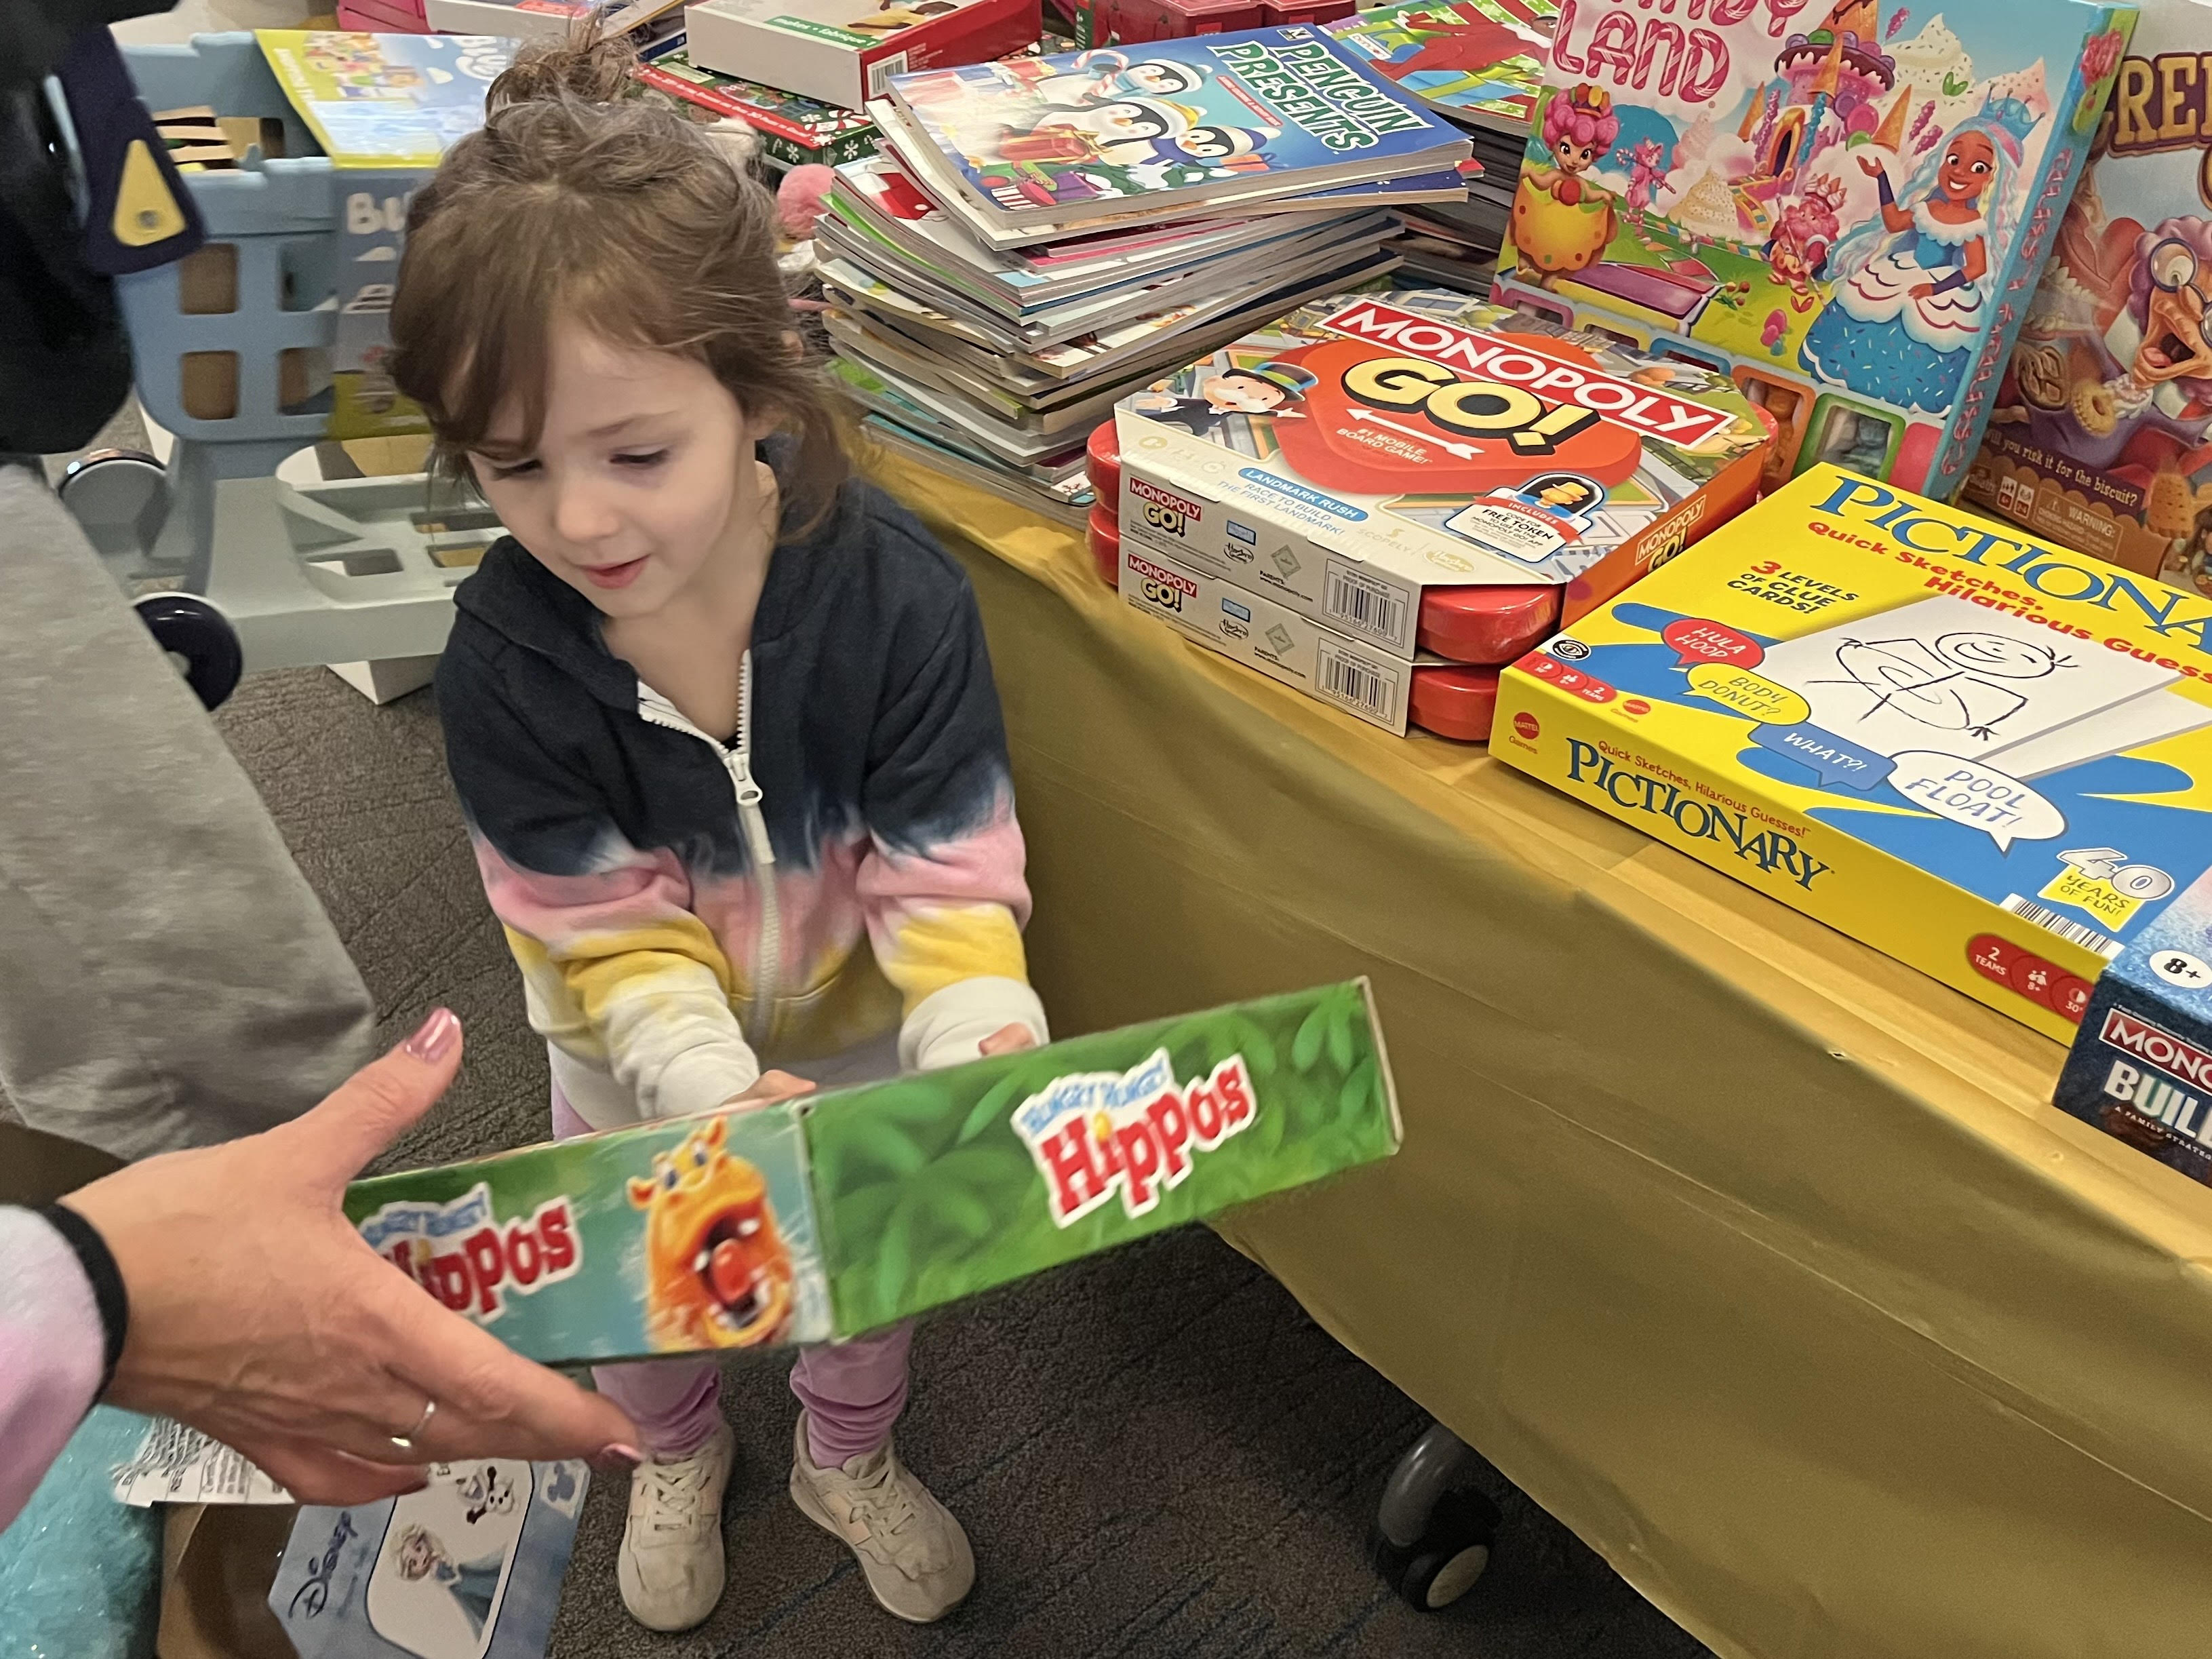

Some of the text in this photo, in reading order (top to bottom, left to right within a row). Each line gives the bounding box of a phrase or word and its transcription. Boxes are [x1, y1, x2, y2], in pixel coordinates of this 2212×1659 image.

[1552, 0, 1730, 102] LAND
[1207, 41, 1379, 151] PRESENTS
[1270, 41, 1433, 132] PENGUIN
[1338, 307, 1716, 432] MONOPOLY
[1342, 357, 1601, 455] GO!
[1337, 428, 1379, 453] BOARD
[1378, 441, 1428, 465] GAME!
[1372, 433, 1426, 456] MOBILE
[2002, 439, 2020, 455] you
[2022, 446, 2042, 465] risk
[2045, 455, 2054, 469] it
[2055, 461, 2072, 478] for
[2075, 469, 2093, 487] the
[2094, 477, 2138, 507] biscuit?
[1130, 480, 1201, 519] MONOPOLY
[1217, 481, 1240, 492] THE
[1240, 489, 1273, 508] FIRST
[1273, 503, 1346, 536] LANDMARK!
[1244, 484, 1332, 521] RACE TO BUILD
[1246, 470, 1360, 519] LANDMARK RUSH
[1143, 501, 1185, 538] GO!
[1471, 516, 1513, 535] MONOPOLY
[1482, 509, 1509, 524] FREE
[1514, 520, 1555, 541] TOKEN
[1508, 502, 1559, 525] INCLUDES
[1526, 520, 1542, 528] FOR
[1638, 500, 1703, 560] MONOPOLY
[2068, 505, 2116, 539] WARNING:
[1648, 526, 1687, 572] GO!
[1809, 521, 2044, 611] Quick Sketches,
[1810, 475, 2212, 656] PICTIONA
[1129, 556, 1197, 596] MONOPOLY
[1141, 577, 1182, 612] GO!
[1740, 573, 1837, 607] OF CLUE
[1750, 561, 1859, 601] 3 LEVELS
[1727, 580, 1821, 614] CARDS!
[1924, 575, 2093, 640] Hilarious
[1674, 633, 1731, 659] HOOP
[1691, 626, 1750, 656] HULA
[1594, 686, 1605, 695] 2
[1698, 680, 1782, 717] DONUT?
[1728, 677, 1788, 702] BODY
[1509, 735, 1538, 754] Games
[1514, 720, 1540, 733] MATTEL
[1783, 732, 1868, 773] WHAT?!
[1598, 739, 1806, 838] Quick Sketches, Hilarious Guesses!
[1905, 777, 2023, 829] FLOAT!
[1945, 768, 2030, 809] POOL
[1566, 737, 1832, 892] PICTIONARY
[2059, 848, 2173, 900] 40
[2066, 875, 2131, 910] YEARS
[2060, 885, 2122, 916] OF FUN!
[1975, 954, 2007, 975] TEAMS
[1988, 946, 2000, 961] 2
[2163, 958, 2201, 979] 8+
[1040, 1065, 1250, 1215] Hippos
[2125, 1111, 2164, 1134] FAMILY
[288, 1511, 360, 1620] Disney
